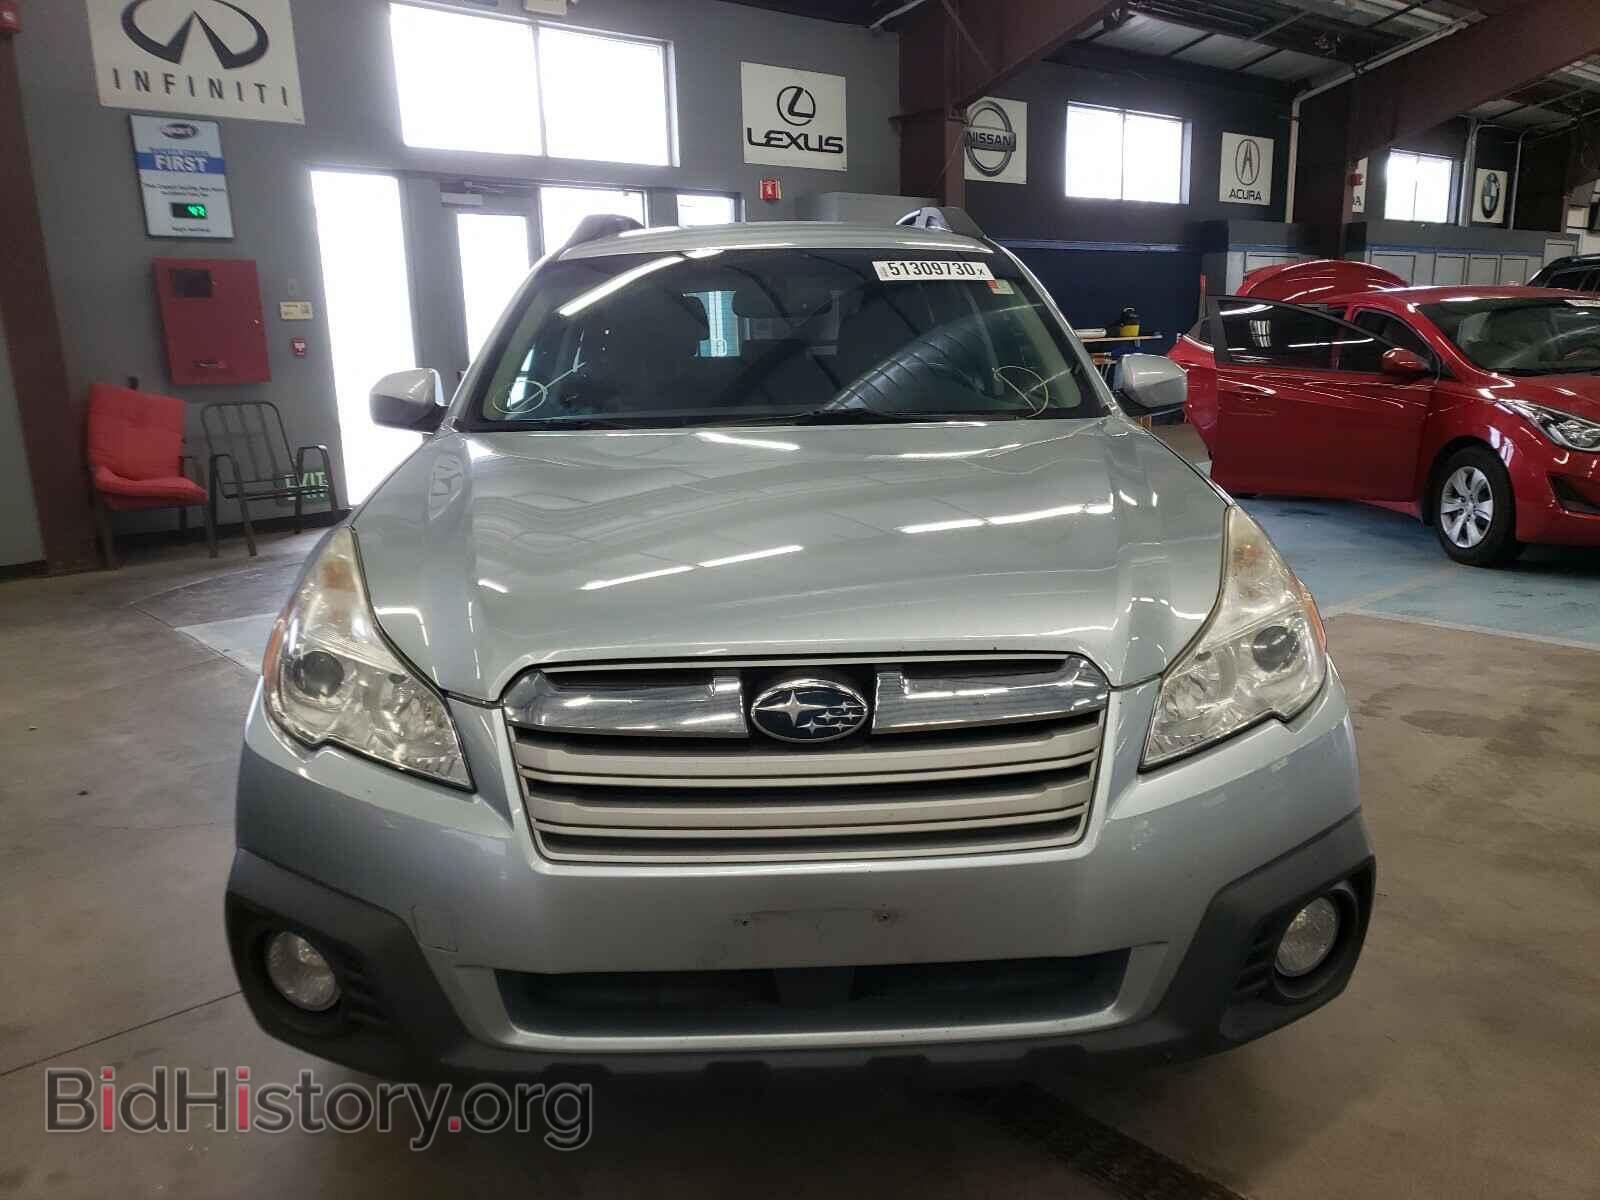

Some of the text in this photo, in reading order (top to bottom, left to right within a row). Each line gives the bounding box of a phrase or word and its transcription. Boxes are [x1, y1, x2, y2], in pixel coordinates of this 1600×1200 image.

[111, 67, 289, 106] INFINITI
[747, 127, 844, 154] LEXUS
[966, 130, 1011, 146] NISSAN
[154, 154, 208, 173] FIRST
[1229, 188, 1262, 201] ACURA
[887, 262, 976, 276] 51309730
